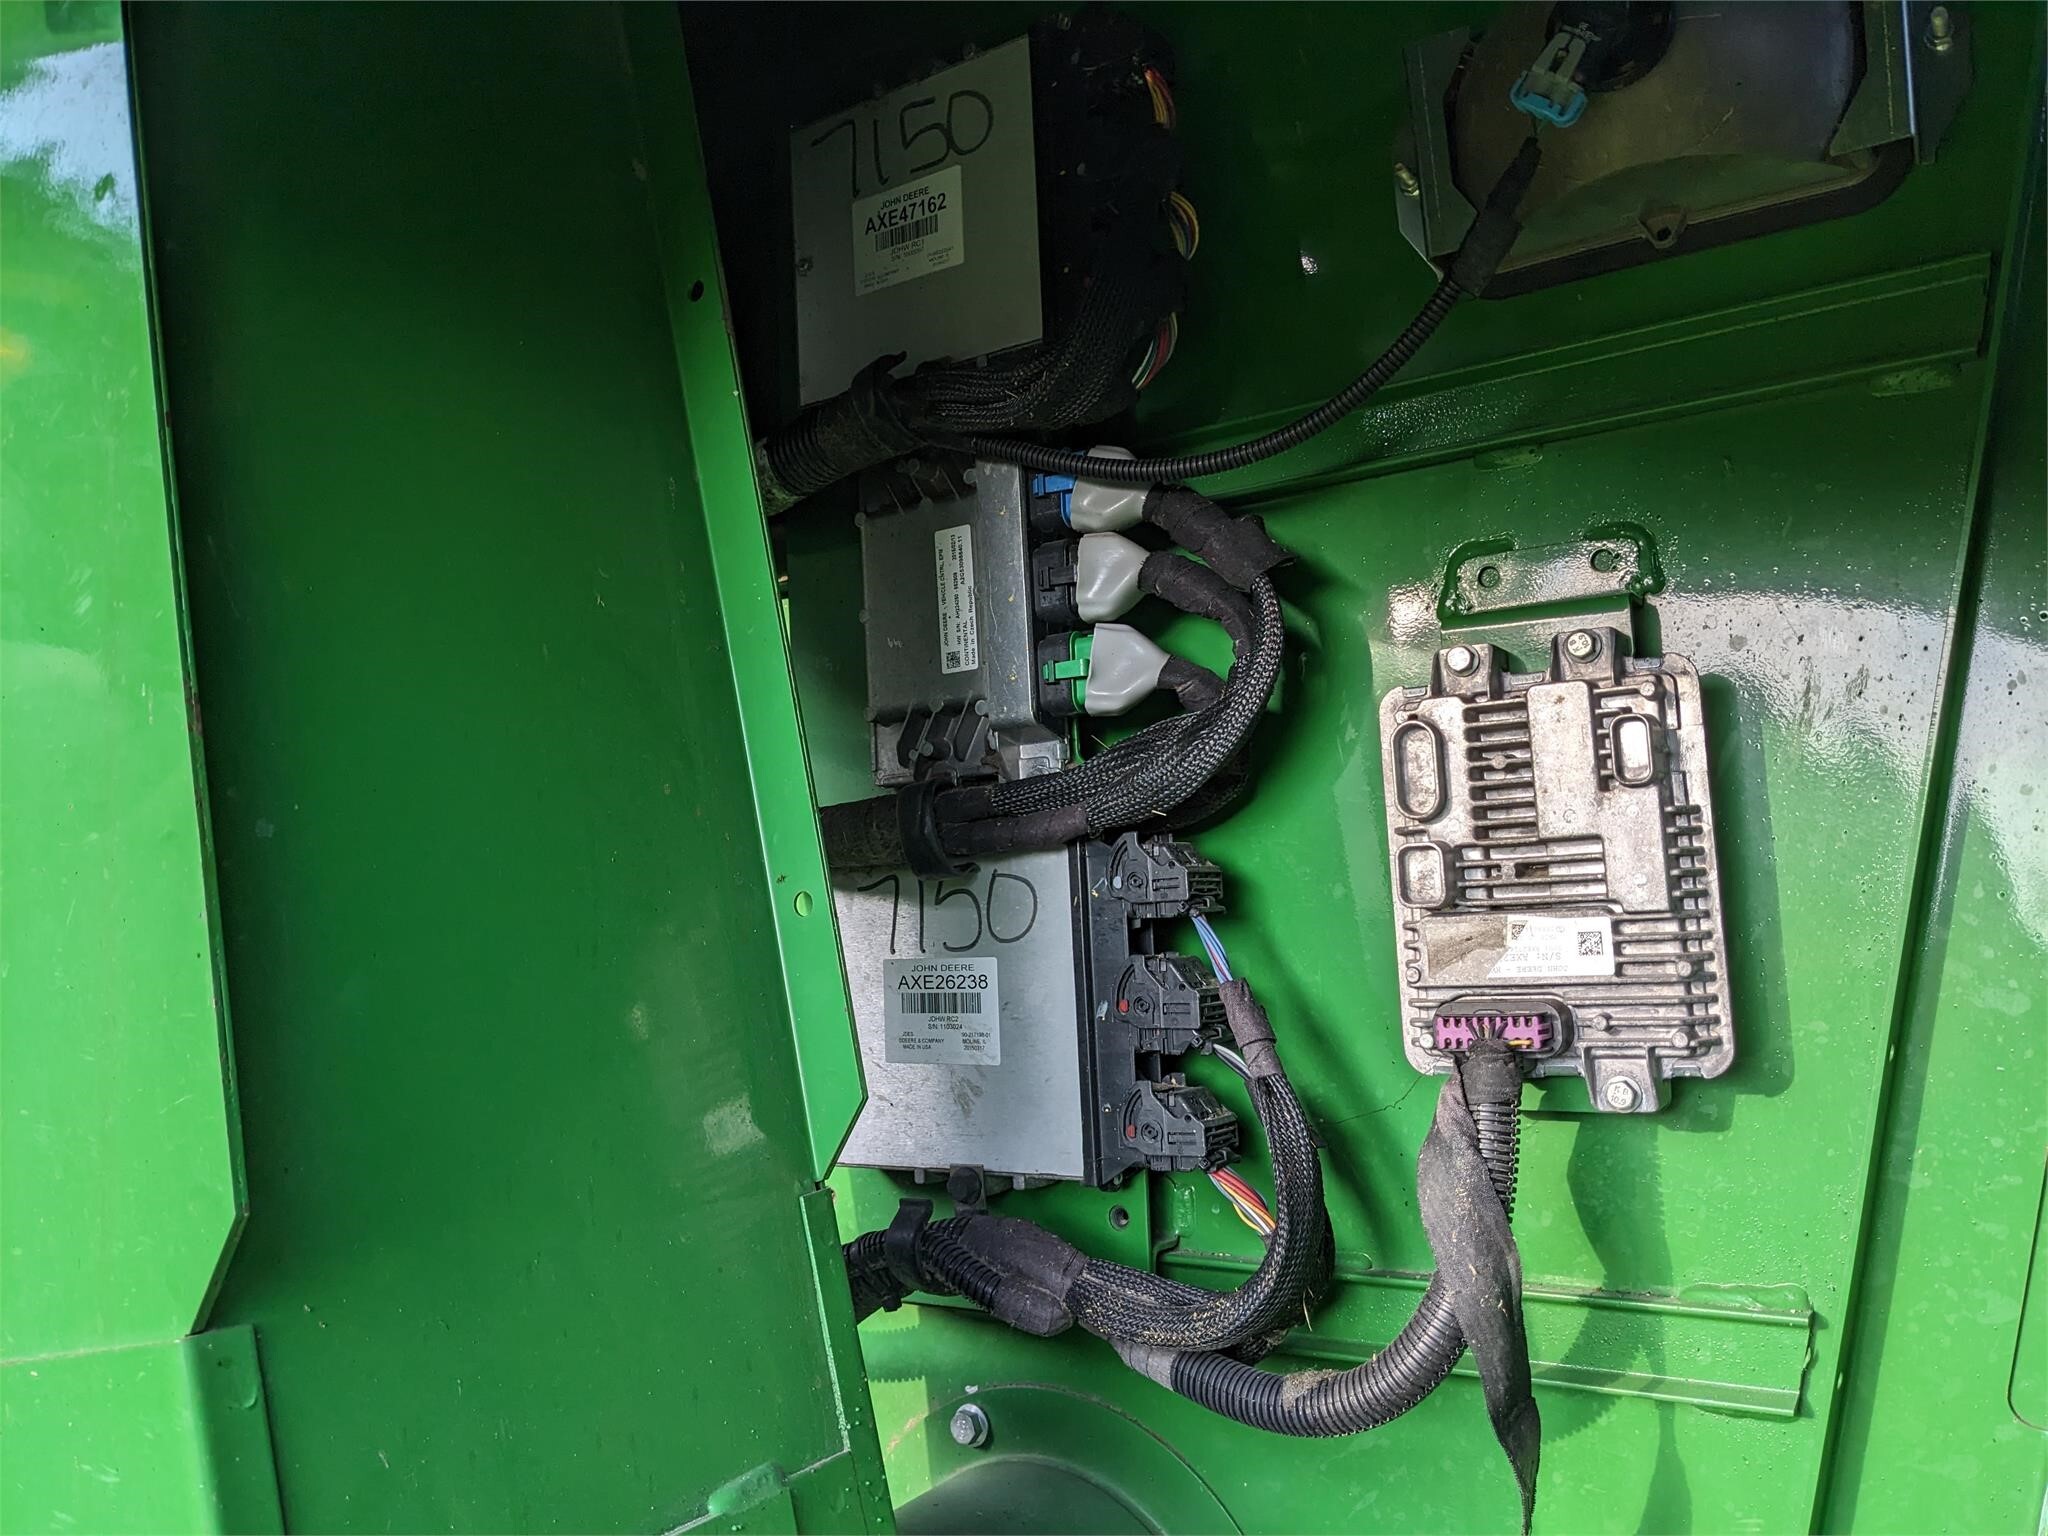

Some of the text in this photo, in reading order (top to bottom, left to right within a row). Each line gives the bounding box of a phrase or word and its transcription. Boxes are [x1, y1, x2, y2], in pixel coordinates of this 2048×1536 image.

[810, 90, 994, 198] 7150
[865, 192, 947, 235] AXE47162
[881, 186, 930, 210] JOHN DEERE
[857, 868, 1038, 954] 7150
[898, 974, 988, 990] AXE26238
[911, 964, 975, 972] JOHN DEERE
